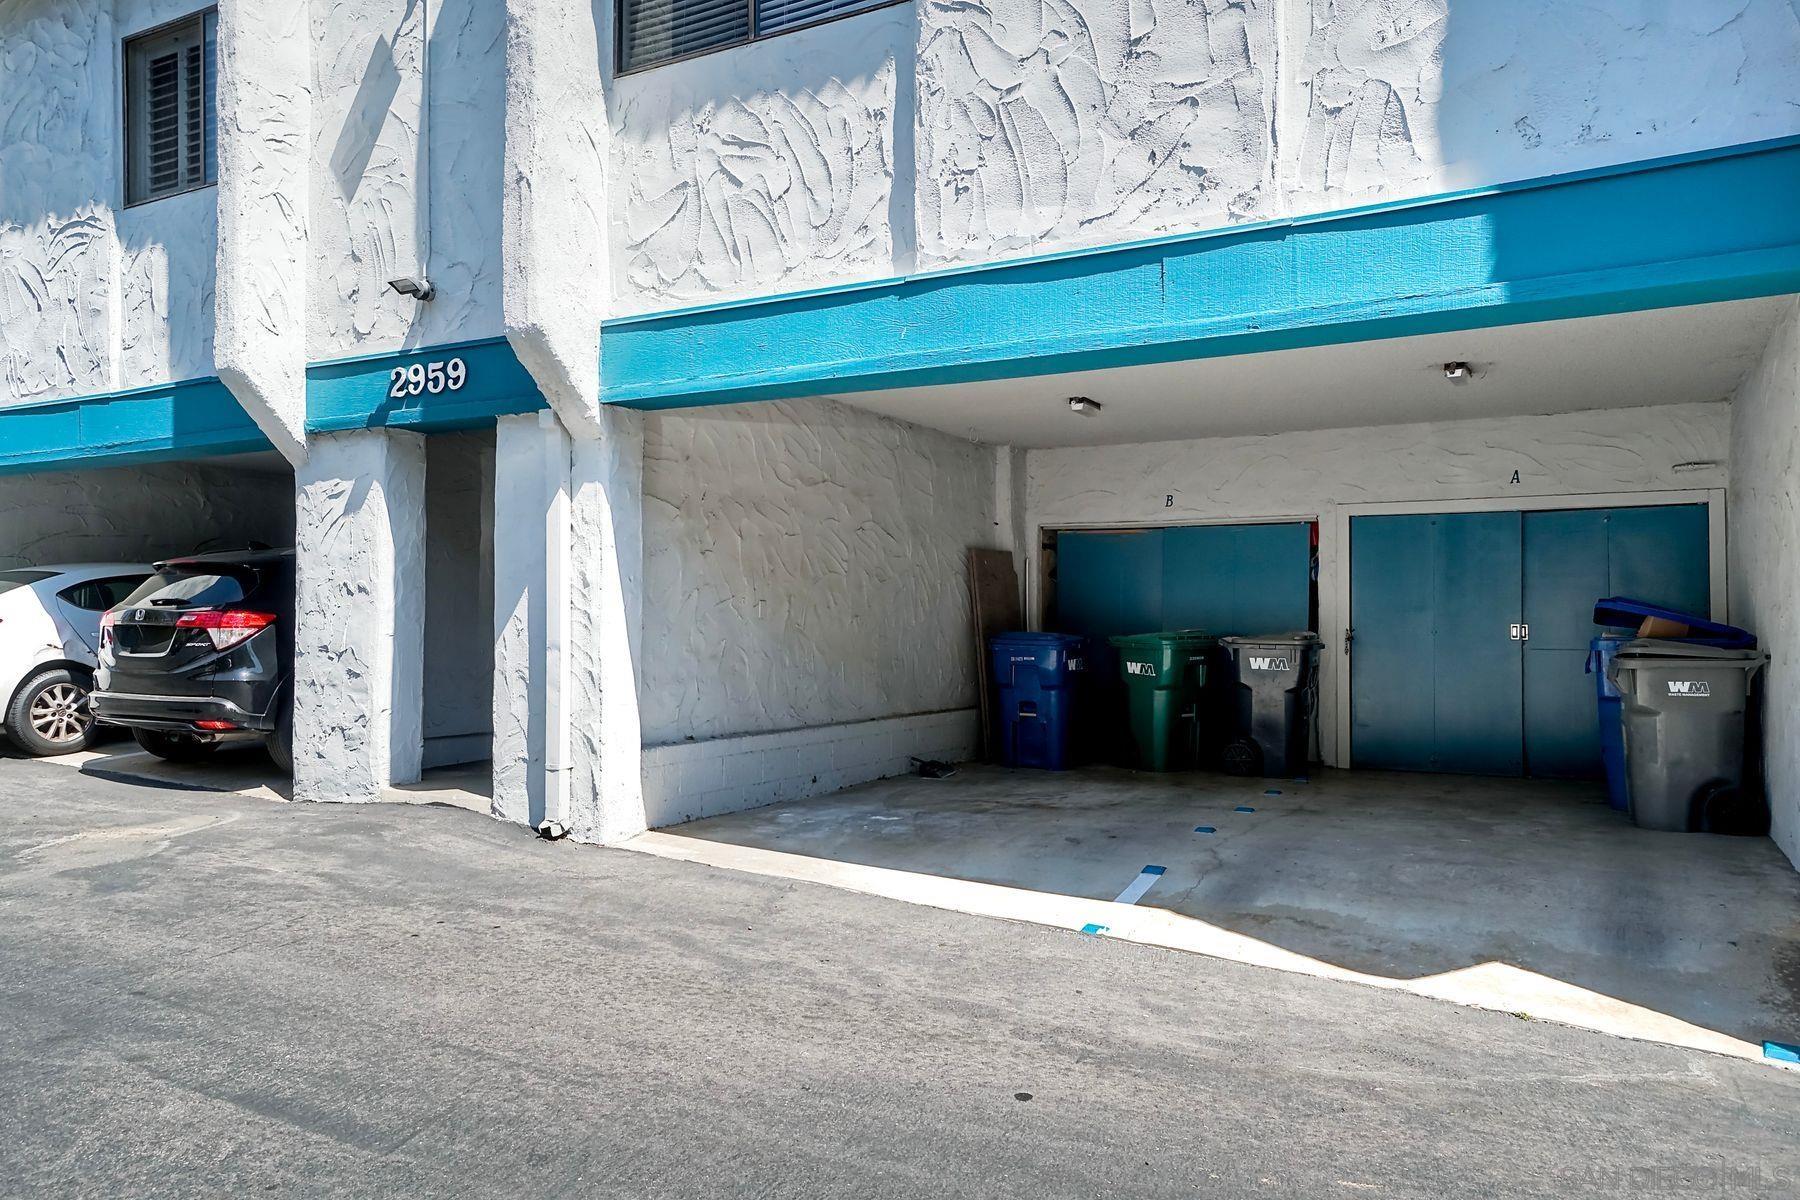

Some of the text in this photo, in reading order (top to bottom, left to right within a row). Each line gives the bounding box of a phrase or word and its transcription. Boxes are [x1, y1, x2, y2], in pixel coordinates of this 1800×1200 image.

[390, 357, 466, 398] 2959
[1510, 469, 1520, 484] A
[1165, 494, 1174, 507] B
[1250, 657, 1290, 671] WM
[1667, 681, 1711, 693] WM
